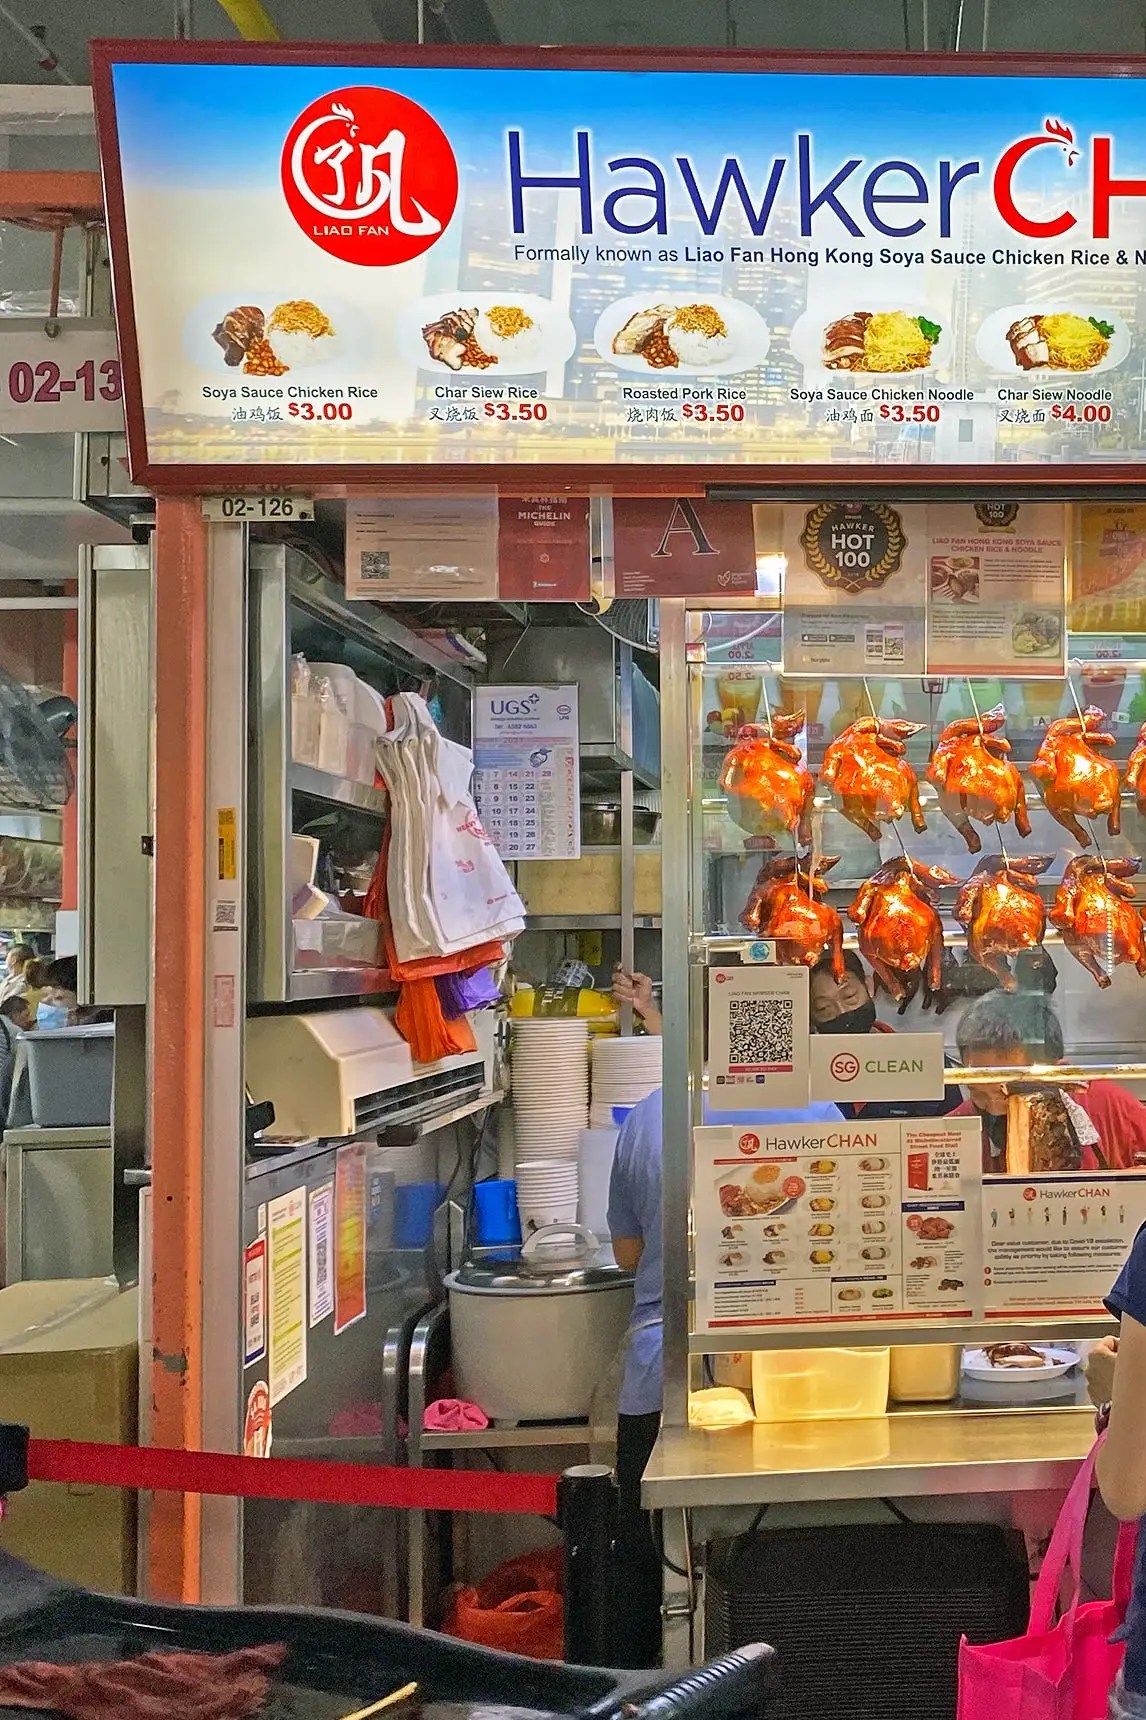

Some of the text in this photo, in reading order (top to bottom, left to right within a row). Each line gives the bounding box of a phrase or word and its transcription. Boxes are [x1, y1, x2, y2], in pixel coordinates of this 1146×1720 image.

[313, 225, 389, 236] LIAO FAN
[513, 244, 590, 266] Formally
[595, 245, 652, 263] known
[658, 250, 678, 263] as
[685, 246, 724, 264] Liao
[730, 247, 764, 264] Fan
[771, 247, 819, 268] Hong
[825, 248, 873, 269] Kong
[879, 248, 925, 269] Soya
[930, 248, 986, 266] Sauce
[992, 248, 1065, 266] Chicken
[1071, 249, 1109, 266] Rice
[1115, 250, 1129, 266] &
[202, 386, 378, 400] Soya Sauce Chicken Rice
[435, 386, 538, 399] Char Siew Rice
[623, 387, 747, 400] Roasted Pork Rice
[790, 388, 974, 402] Soya Sauce Chicken Noodle
[998, 388, 1112, 401] Char Siew Noodle
[231, 402, 353, 422] 油鸡饭 $3.00
[484, 402, 548, 421] $3.50
[626, 404, 745, 423] 烧肉饭 $3.50
[826, 404, 940, 423] 油鸡面 $3.50
[1051, 405, 1112, 423] $4.00
[221, 498, 294, 517] 02-126
[518, 511, 571, 520] MICHELIN
[651, 497, 721, 557] A
[831, 523, 876, 533] HAWKER
[831, 534, 875, 551] HOT
[834, 551, 871, 568] 100
[490, 700, 531, 715] UGS
[835, 1060, 924, 1073] SG CLEAN
